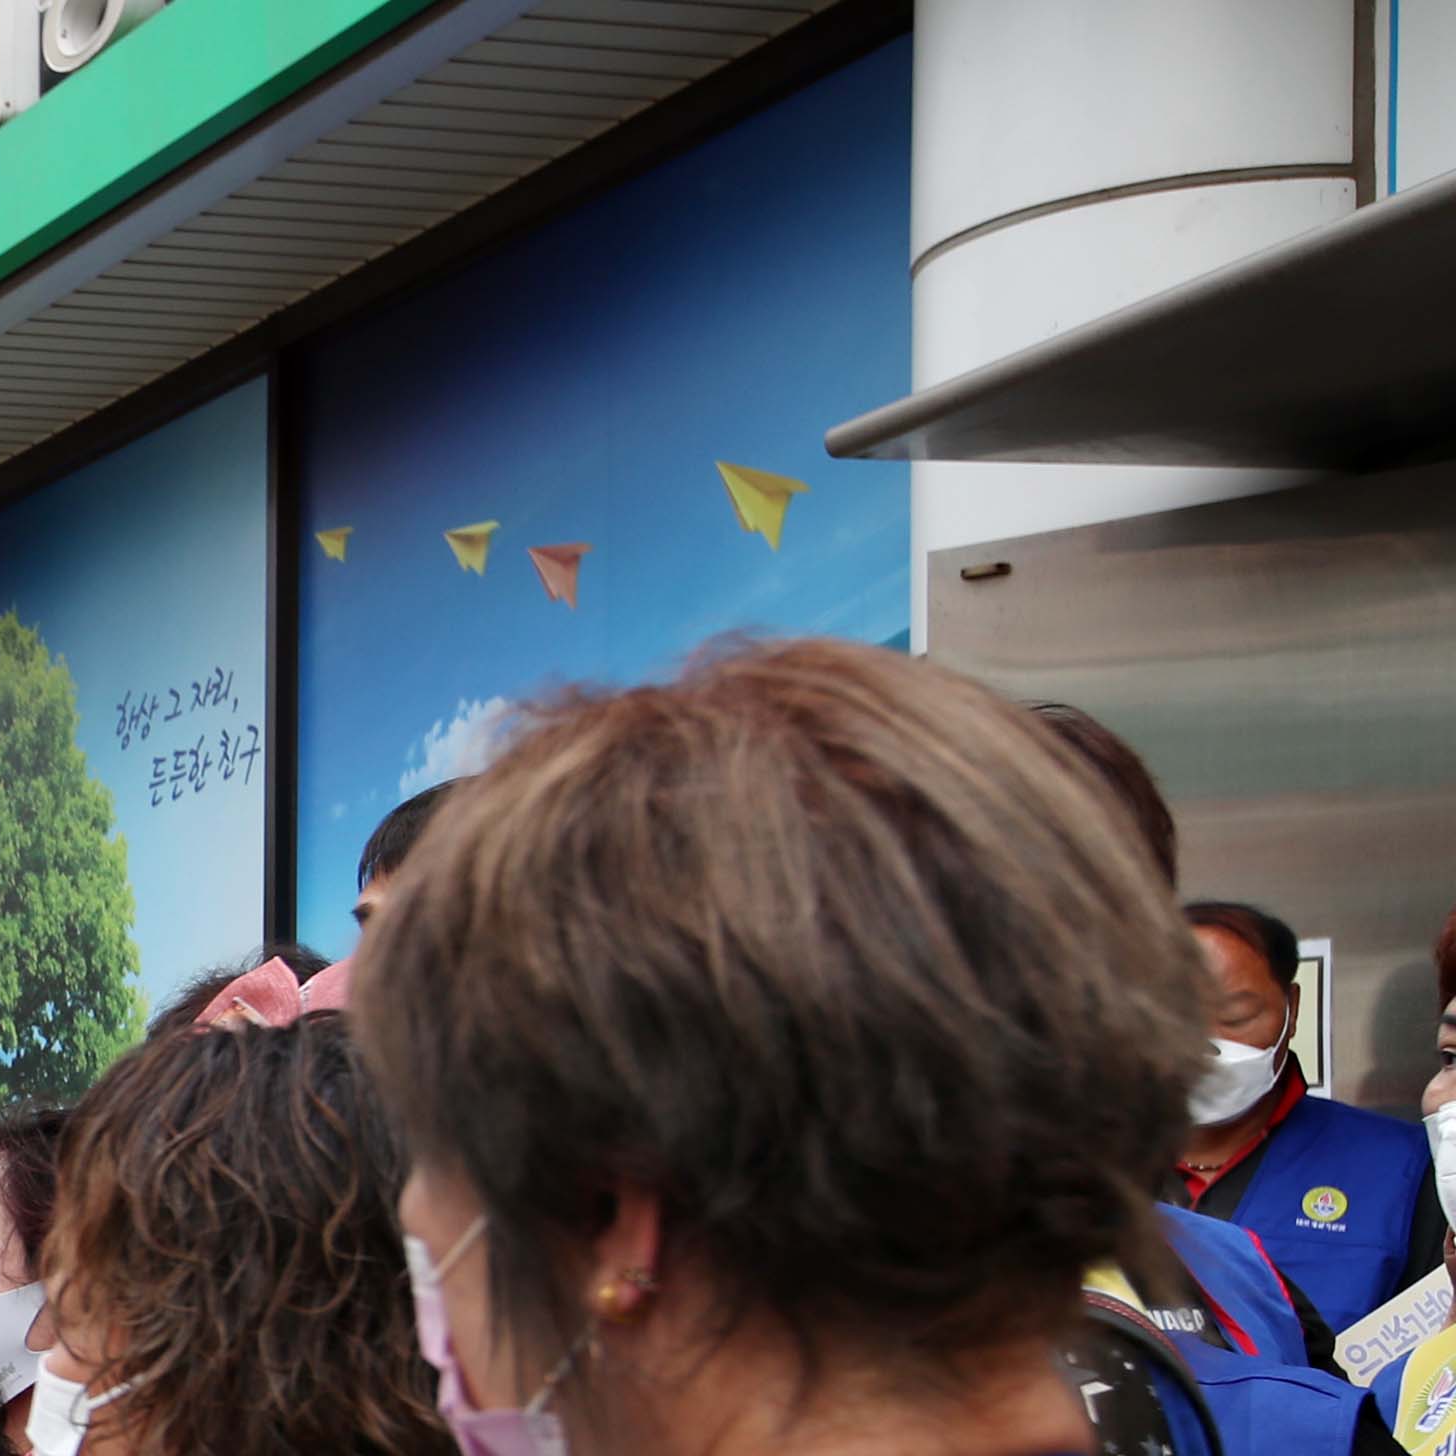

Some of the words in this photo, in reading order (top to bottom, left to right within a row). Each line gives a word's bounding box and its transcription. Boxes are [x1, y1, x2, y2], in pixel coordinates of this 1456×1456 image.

[115, 690, 159, 750] 항상
[164, 688, 182, 722] 그
[149, 734, 213, 807] 든든한
[218, 724, 261, 785] 친구
